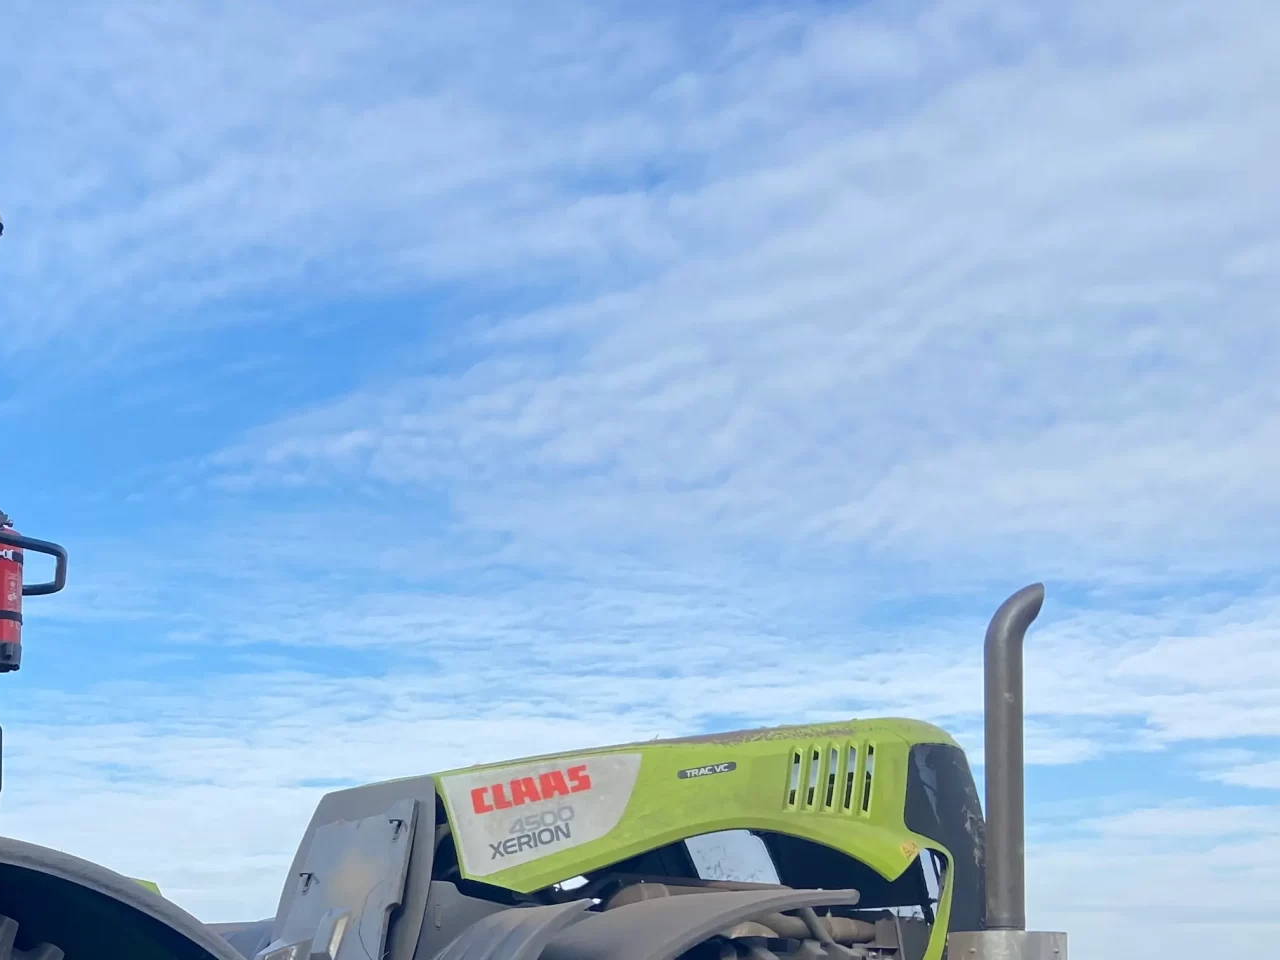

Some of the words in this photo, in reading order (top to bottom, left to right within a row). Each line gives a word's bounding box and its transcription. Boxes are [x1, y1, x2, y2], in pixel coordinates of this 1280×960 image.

[685, 766, 713, 778] TRAC
[714, 763, 729, 773] VC
[470, 764, 592, 815] CLAAS
[508, 805, 575, 835] 4500
[488, 822, 571, 860] XERION
